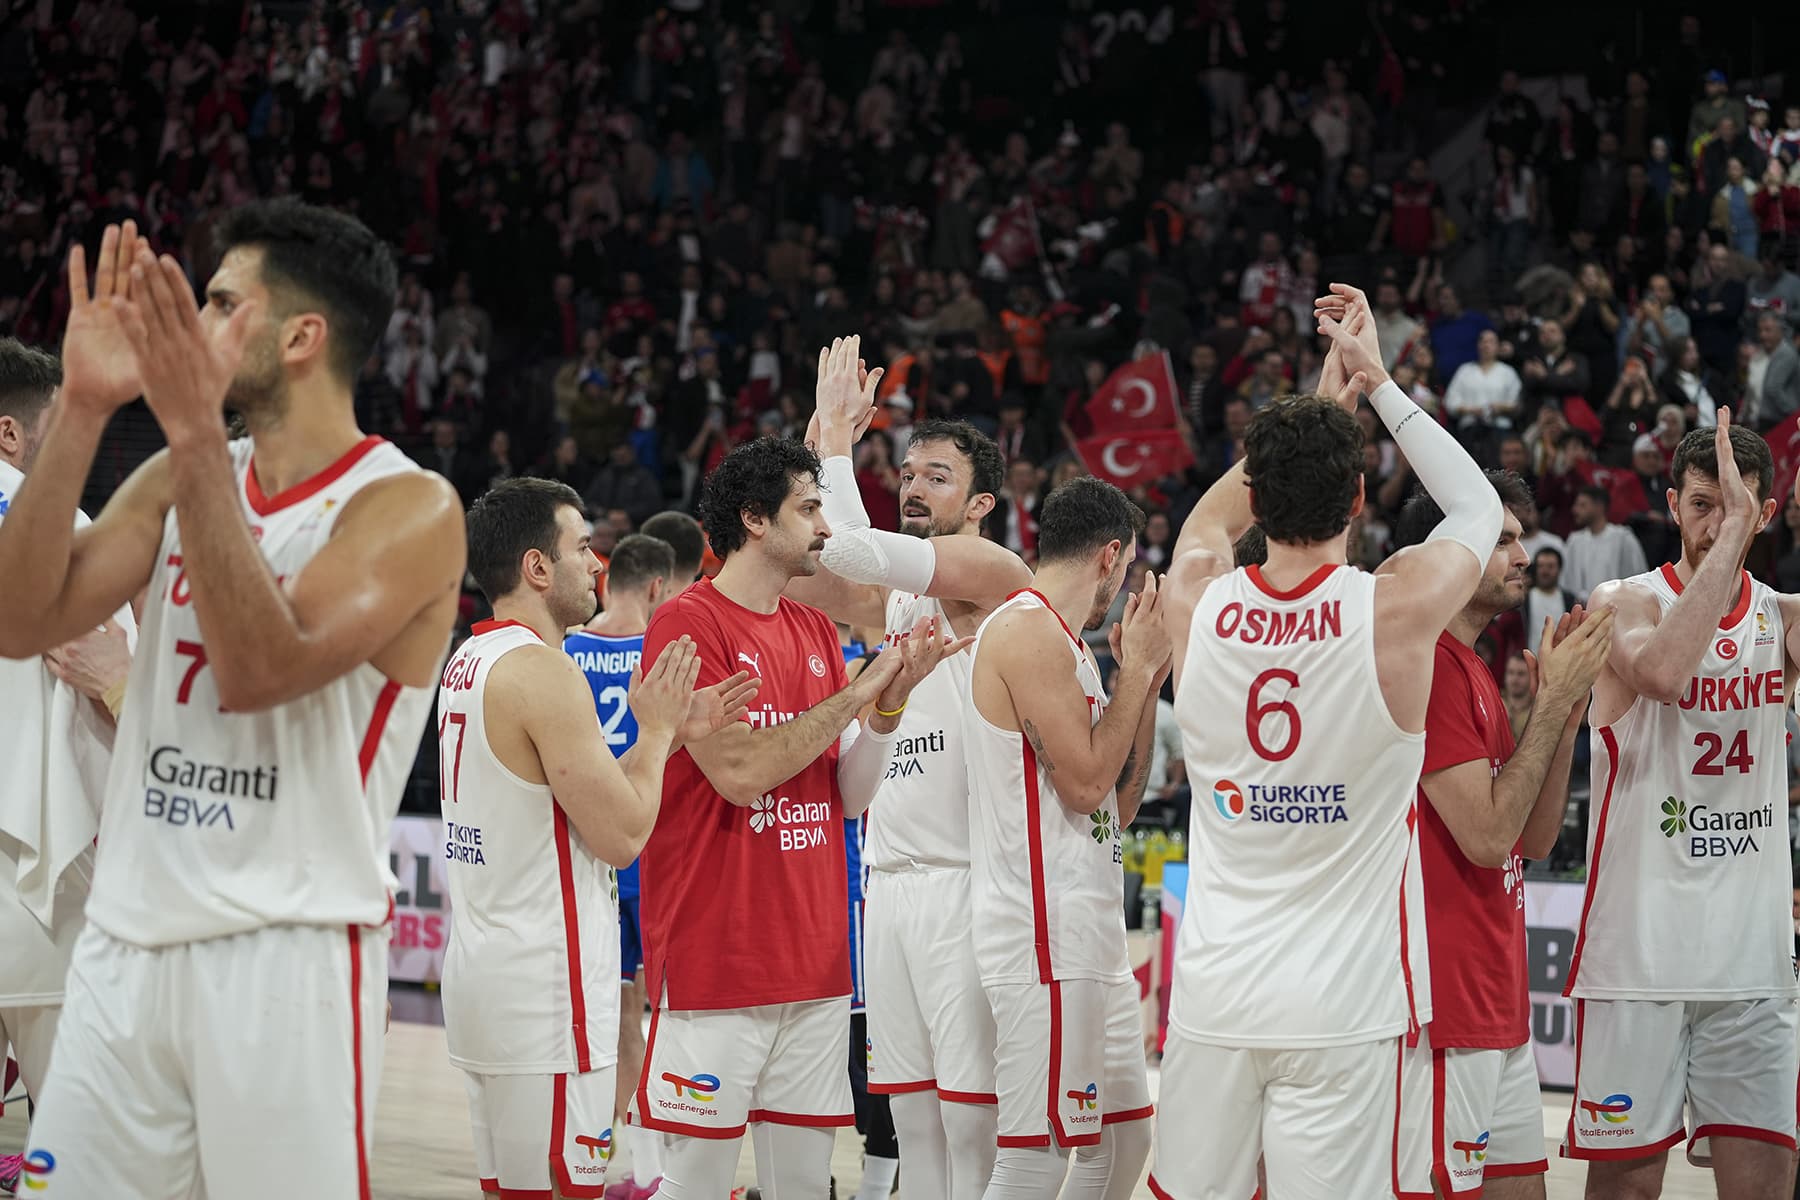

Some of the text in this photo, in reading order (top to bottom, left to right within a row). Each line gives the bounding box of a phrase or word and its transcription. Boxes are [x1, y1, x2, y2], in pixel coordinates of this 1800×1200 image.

[1215, 600, 1342, 646] OSMAN
[600, 686, 628, 745] 2
[1246, 668, 1302, 762] 6
[150, 746, 278, 802] Garanti
[440, 710, 466, 803] 17
[1691, 729, 1754, 776] 24
[145, 787, 234, 831] BBVA
[777, 796, 831, 824] Garan
[1689, 802, 1772, 831] Garanti
[780, 825, 828, 851] BBVA
[1691, 833, 1759, 857] BBVA
[658, 1099, 718, 1116] TotalEnergies
